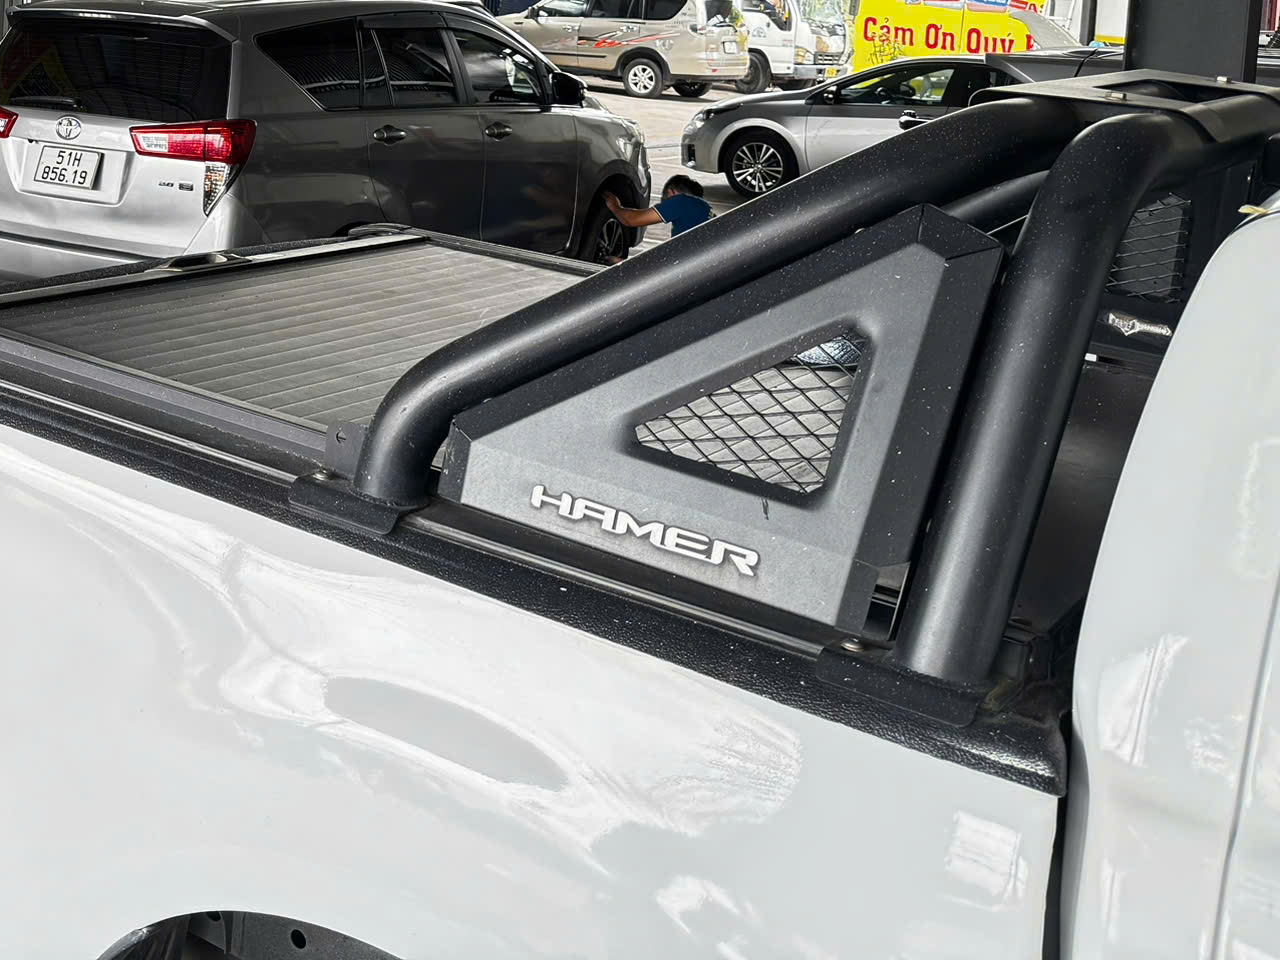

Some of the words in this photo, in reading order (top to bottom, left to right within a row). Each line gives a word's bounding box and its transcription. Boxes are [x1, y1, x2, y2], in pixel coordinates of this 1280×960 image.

[863, 16, 914, 47] Cảm
[925, 21, 955, 52] Ơn
[56, 150, 81, 167] 51H
[41, 166, 88, 186] 856.19
[531, 484, 760, 577] HAMER
